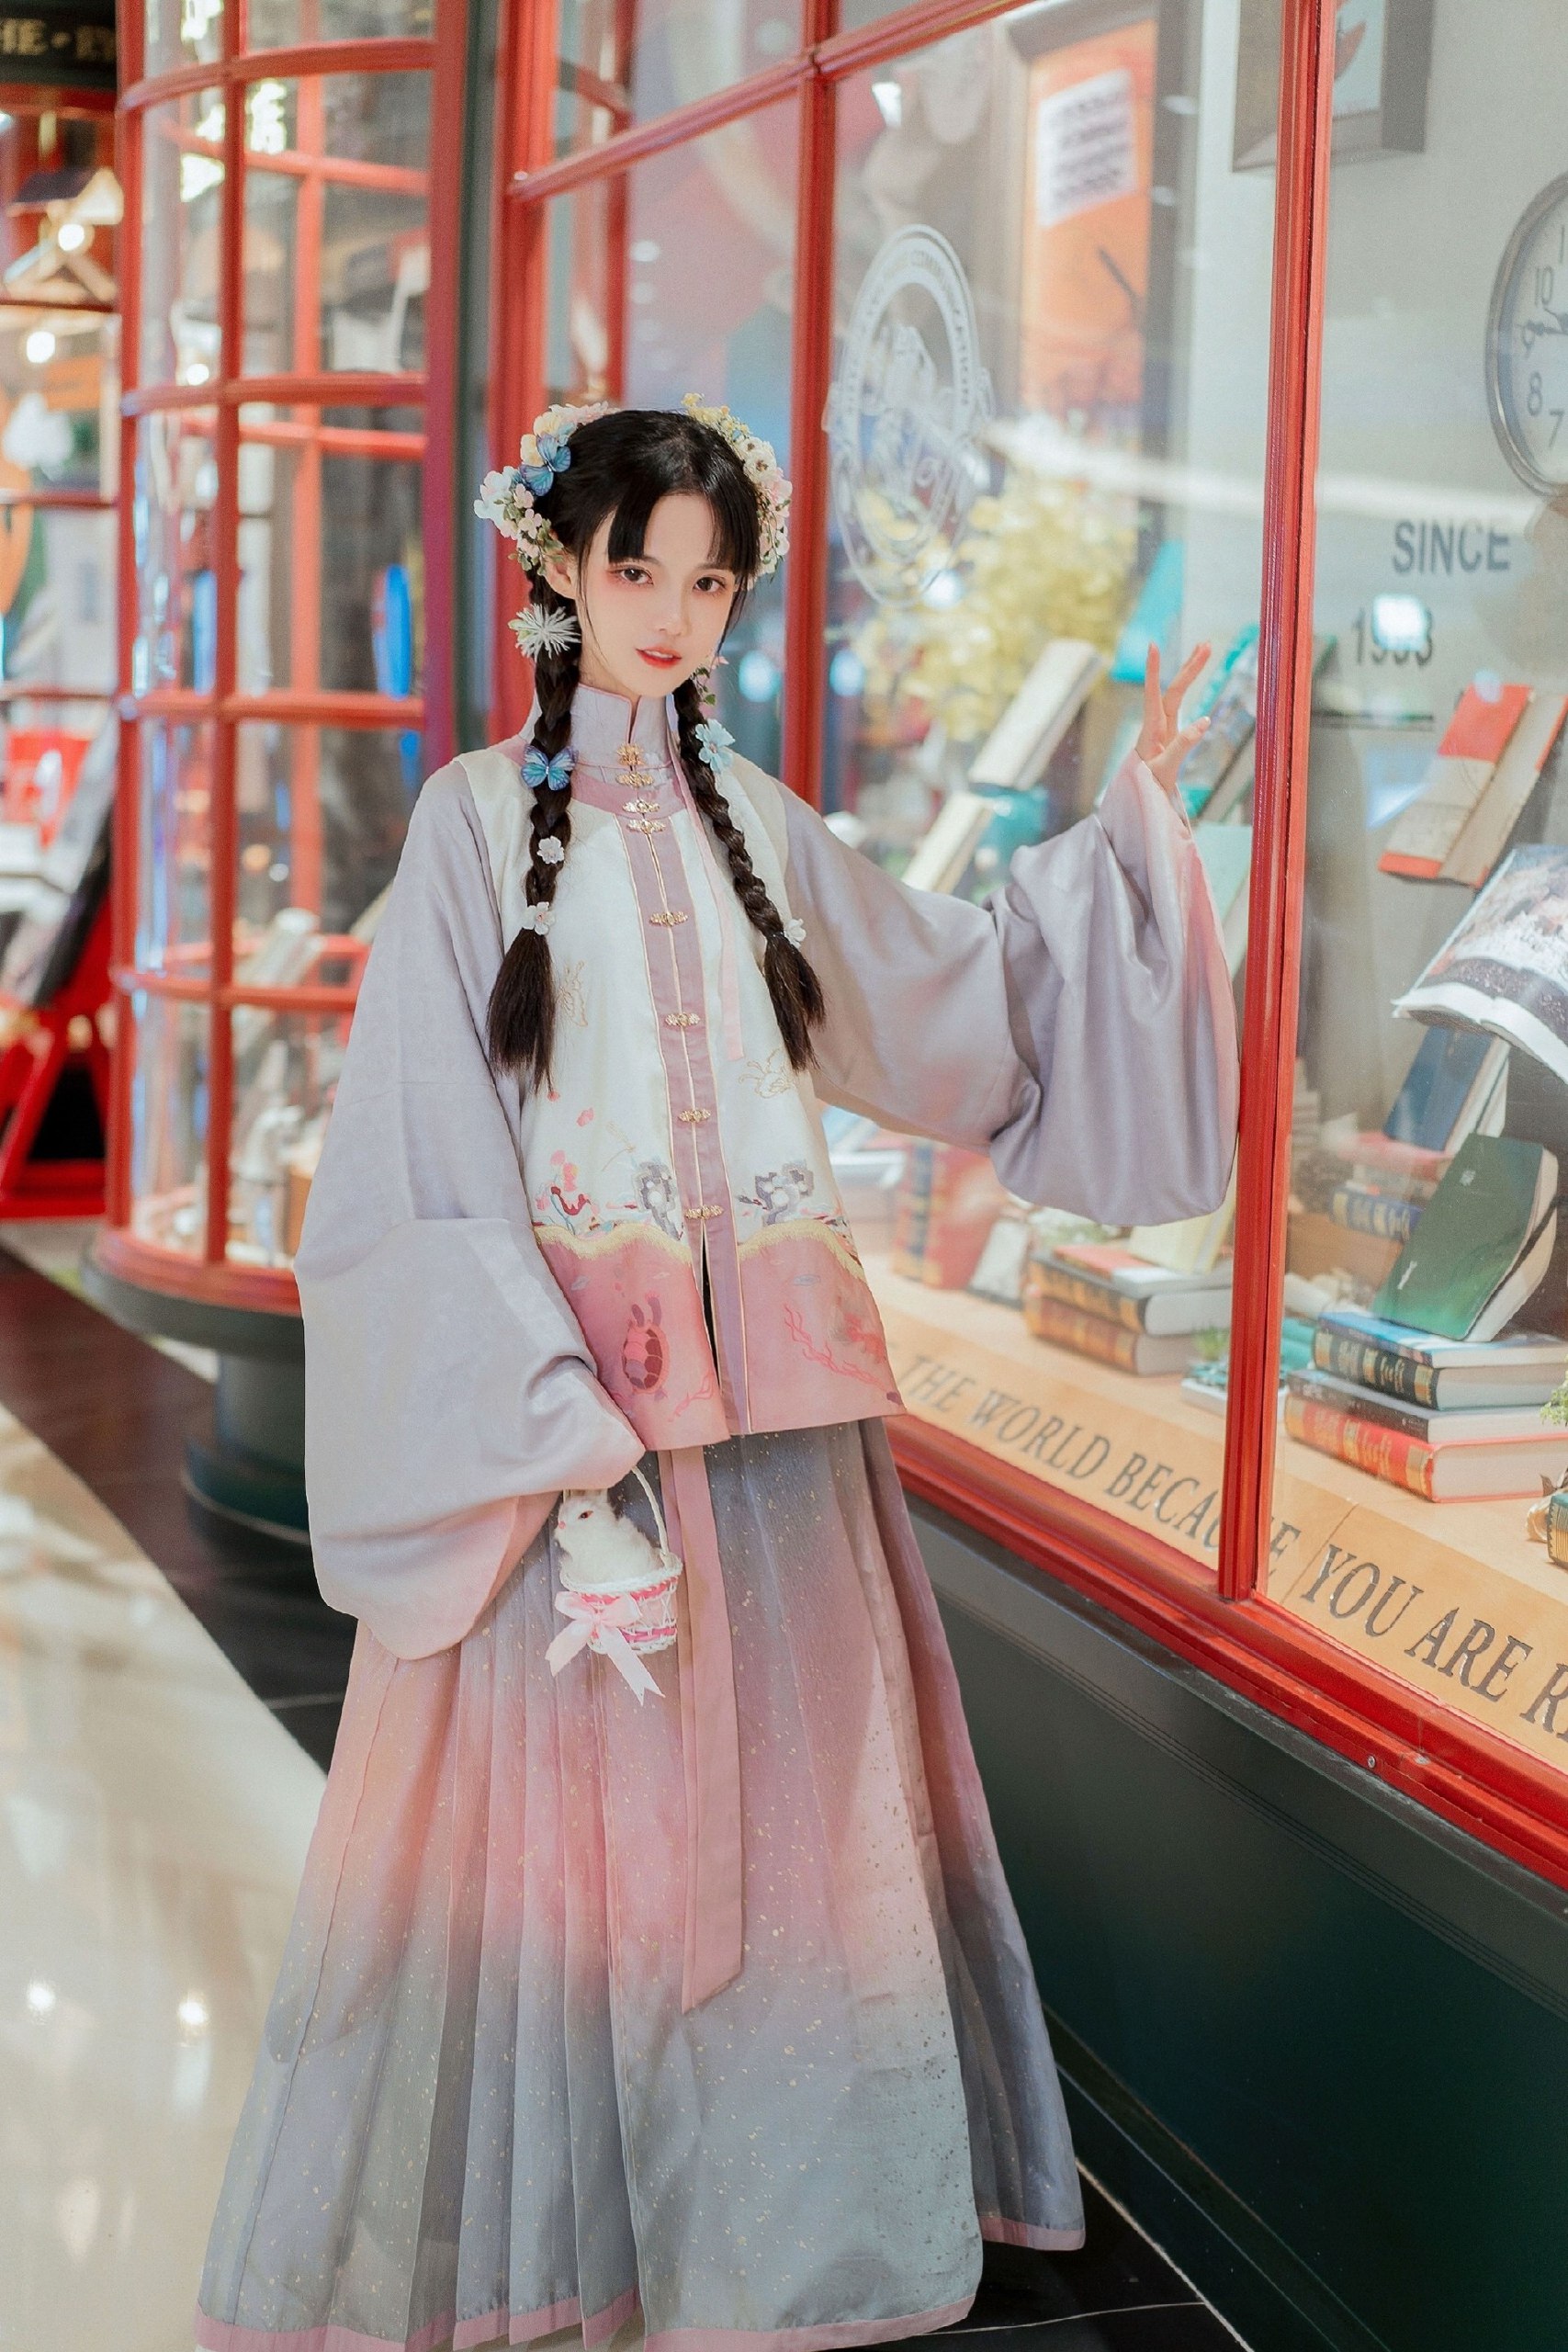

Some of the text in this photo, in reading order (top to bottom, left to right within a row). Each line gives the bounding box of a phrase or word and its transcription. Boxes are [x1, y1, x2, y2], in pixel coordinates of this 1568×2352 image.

[1534, 265, 1554, 307] 10
[1527, 371, 1543, 417] 8
[1549, 409, 1564, 449] 7
[1393, 517, 1511, 575] SINCE
[897, 1353, 977, 1413] THE
[967, 1387, 1111, 1480] WORLD
[1300, 1544, 1424, 1638] YOU
[1404, 1606, 1535, 1703] ARE
[1518, 1662, 1568, 1744] R
